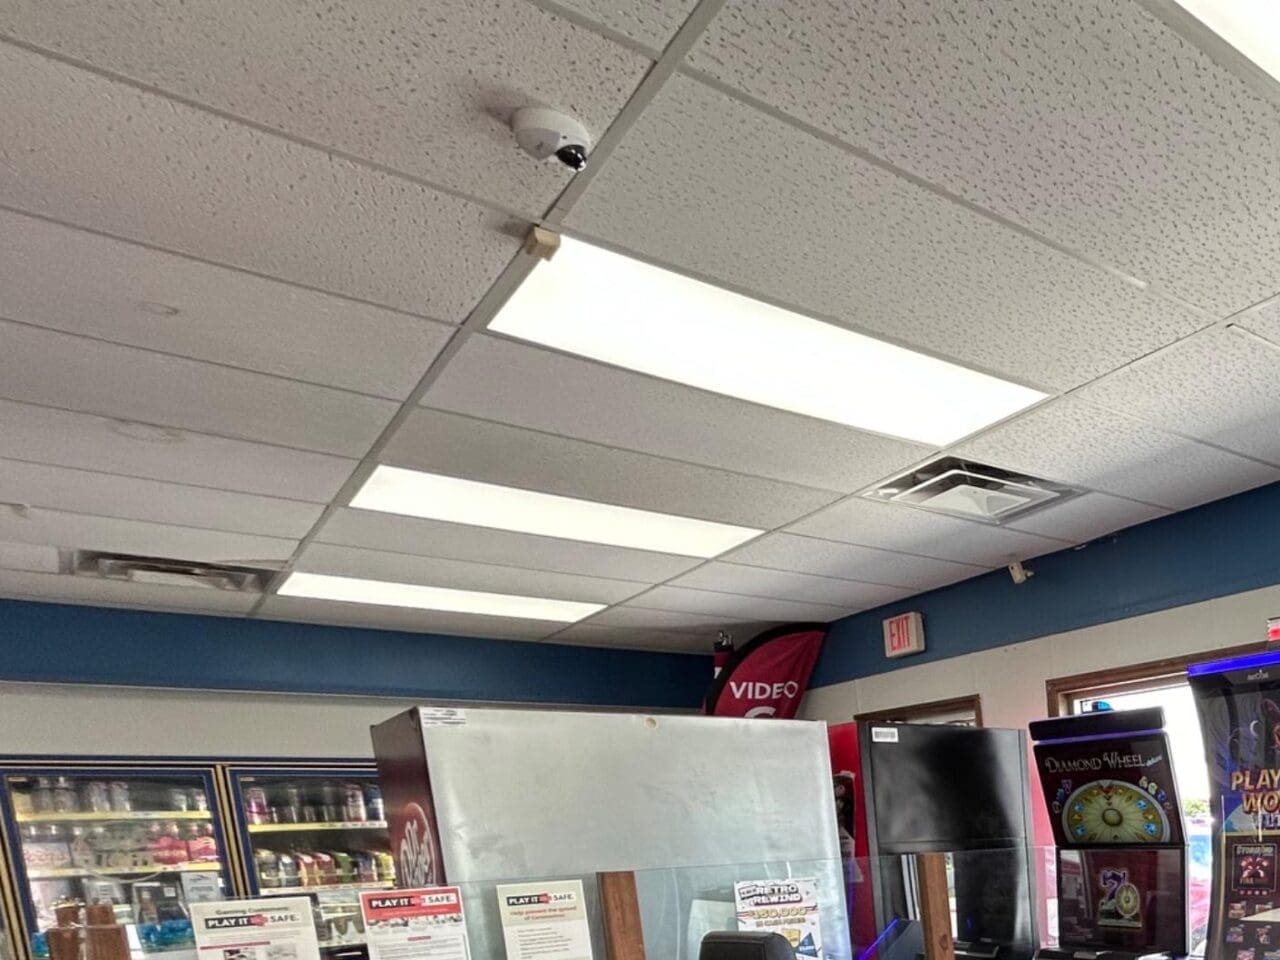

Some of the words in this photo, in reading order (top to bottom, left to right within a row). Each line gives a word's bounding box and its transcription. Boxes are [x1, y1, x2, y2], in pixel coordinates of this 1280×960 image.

[888, 615, 911, 652] EXIT
[730, 681, 799, 700] VIDEO
[1044, 756, 1101, 774] DIAMOND
[371, 899, 398, 908] PLAY
[400, 897, 410, 907] IT
[509, 897, 530, 905] PLAY
[208, 918, 237, 928] PLAY
[239, 917, 248, 926] IT
